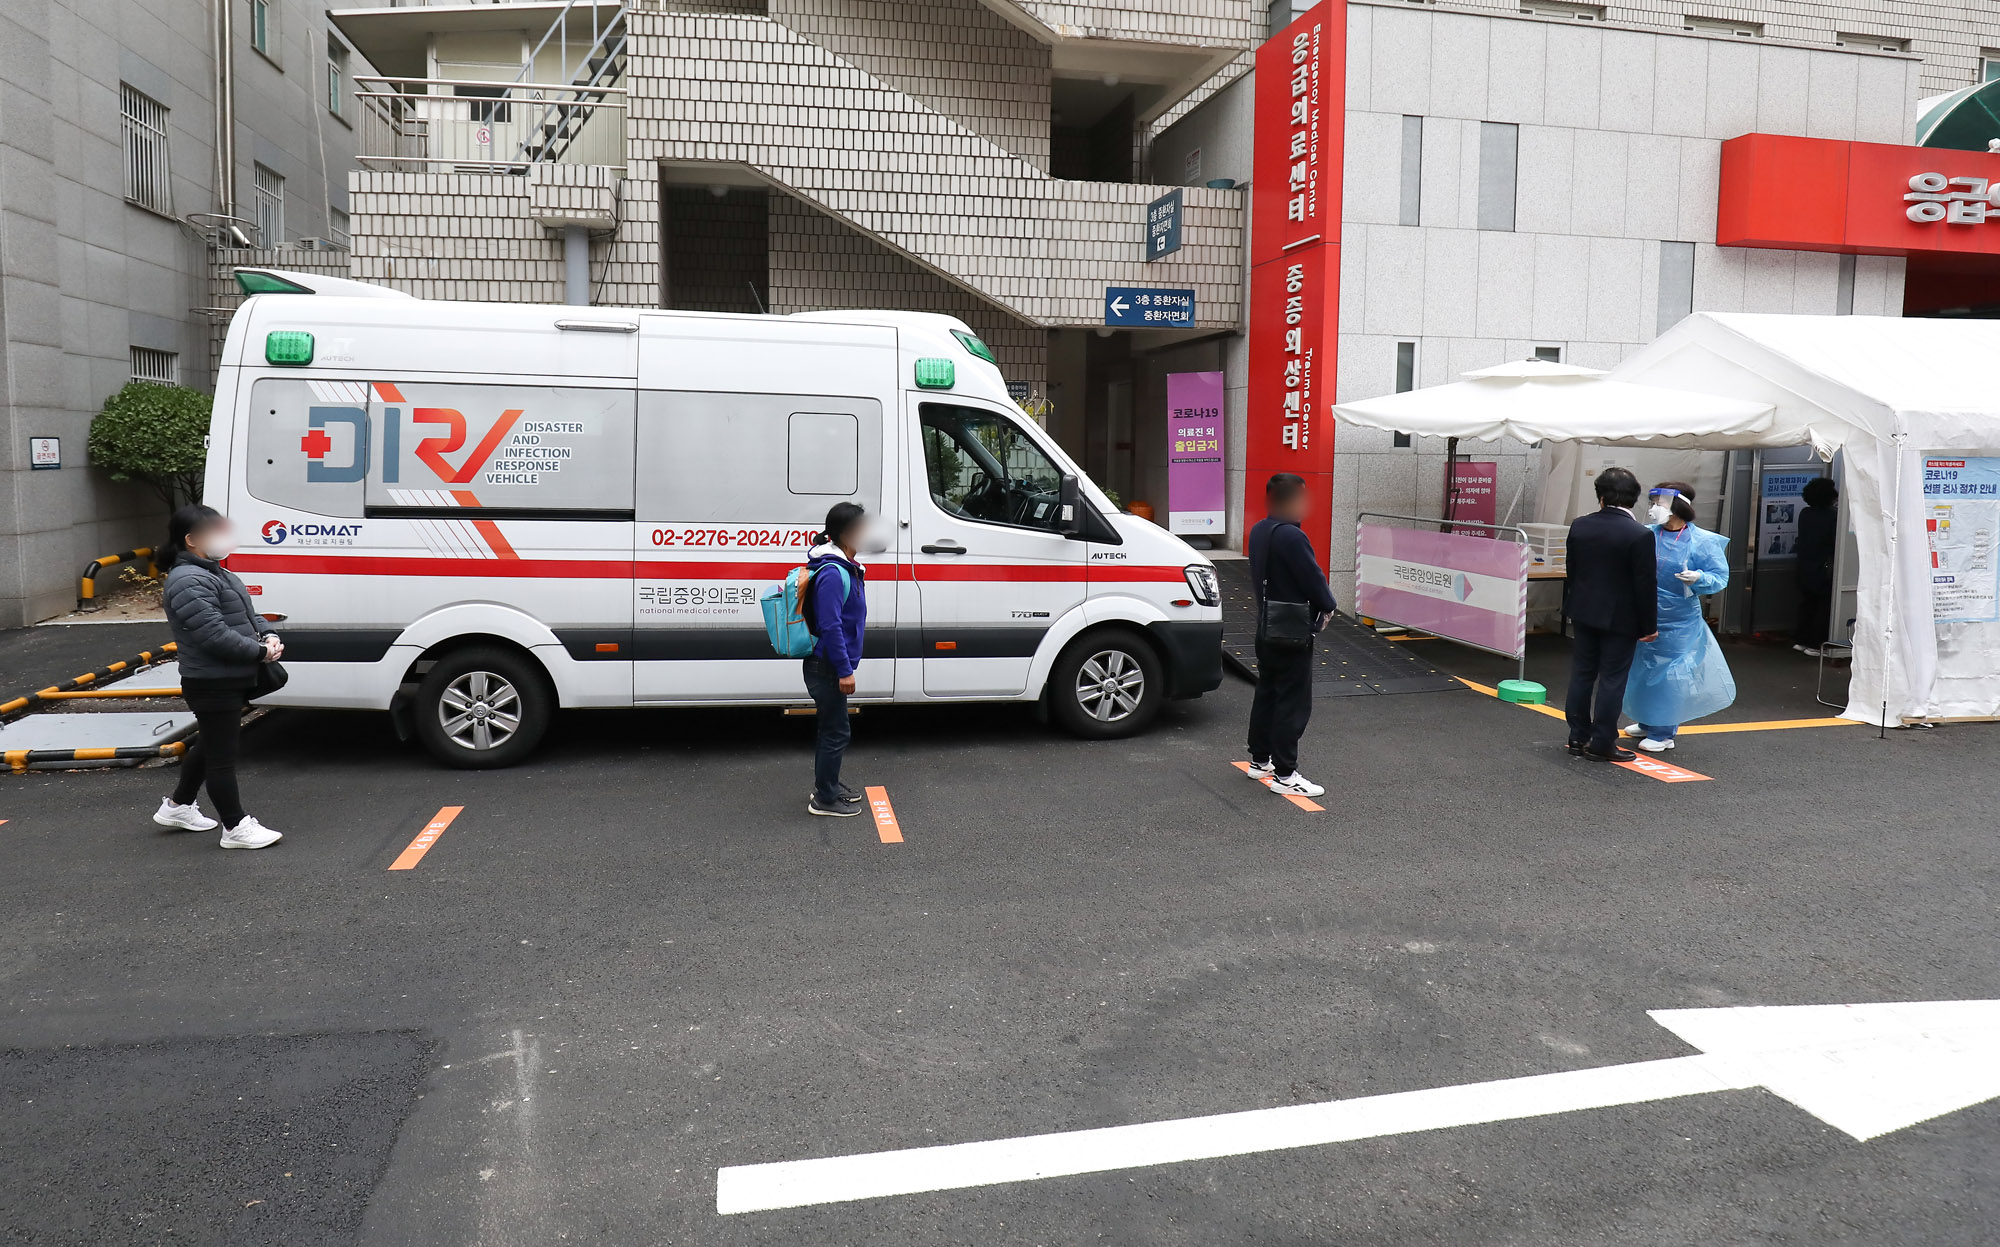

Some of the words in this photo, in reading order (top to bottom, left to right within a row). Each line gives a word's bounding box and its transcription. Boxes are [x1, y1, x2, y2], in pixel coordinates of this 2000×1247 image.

[1311, 23, 1321, 104] Emergency
[1289, 32, 1309, 222] 응급의료센터
[1310, 108, 1319, 165] Medical
[1309, 170, 1318, 217] Center
[1150, 209, 1158, 223] 3층
[1158, 200, 1175, 220] 중환자실
[1152, 217, 1172, 237] 중환자면회
[1135, 295, 1150, 306] 3층
[1153, 295, 1190, 306] 중환자실
[1144, 310, 1189, 321] 중환자면회
[1282, 264, 1304, 450] 중증외상센터
[1303, 348, 1313, 399] Trauma
[1173, 408, 1219, 419] 코로나19
[524, 422, 583, 432] DISASTER
[1178, 428, 1204, 437] 의료진
[1206, 427, 1215, 436] 외
[1302, 403, 1311, 450] Center
[512, 435, 540, 445] AND
[1175, 440, 1218, 452] 출입금지
[505, 448, 570, 458] INFECTION
[495, 461, 559, 471] RESPONSE
[486, 473, 538, 484] VEHICLE
[1925, 470, 1958, 480] 코로나19
[1923, 483, 1941, 495] 선별
[1943, 484, 1958, 495] 검사
[1960, 484, 1978, 495] 절차
[1979, 483, 1997, 495] 안내
[290, 524, 363, 536] KDMAT
[297, 538, 353, 546] 재난의료지원팀
[652, 529, 820, 547] 02-2276-2024/210
[1091, 552, 1127, 560] AUTECH
[1393, 564, 1452, 589] 국립중앙의료원
[639, 587, 756, 605] 국립중앙의료원
